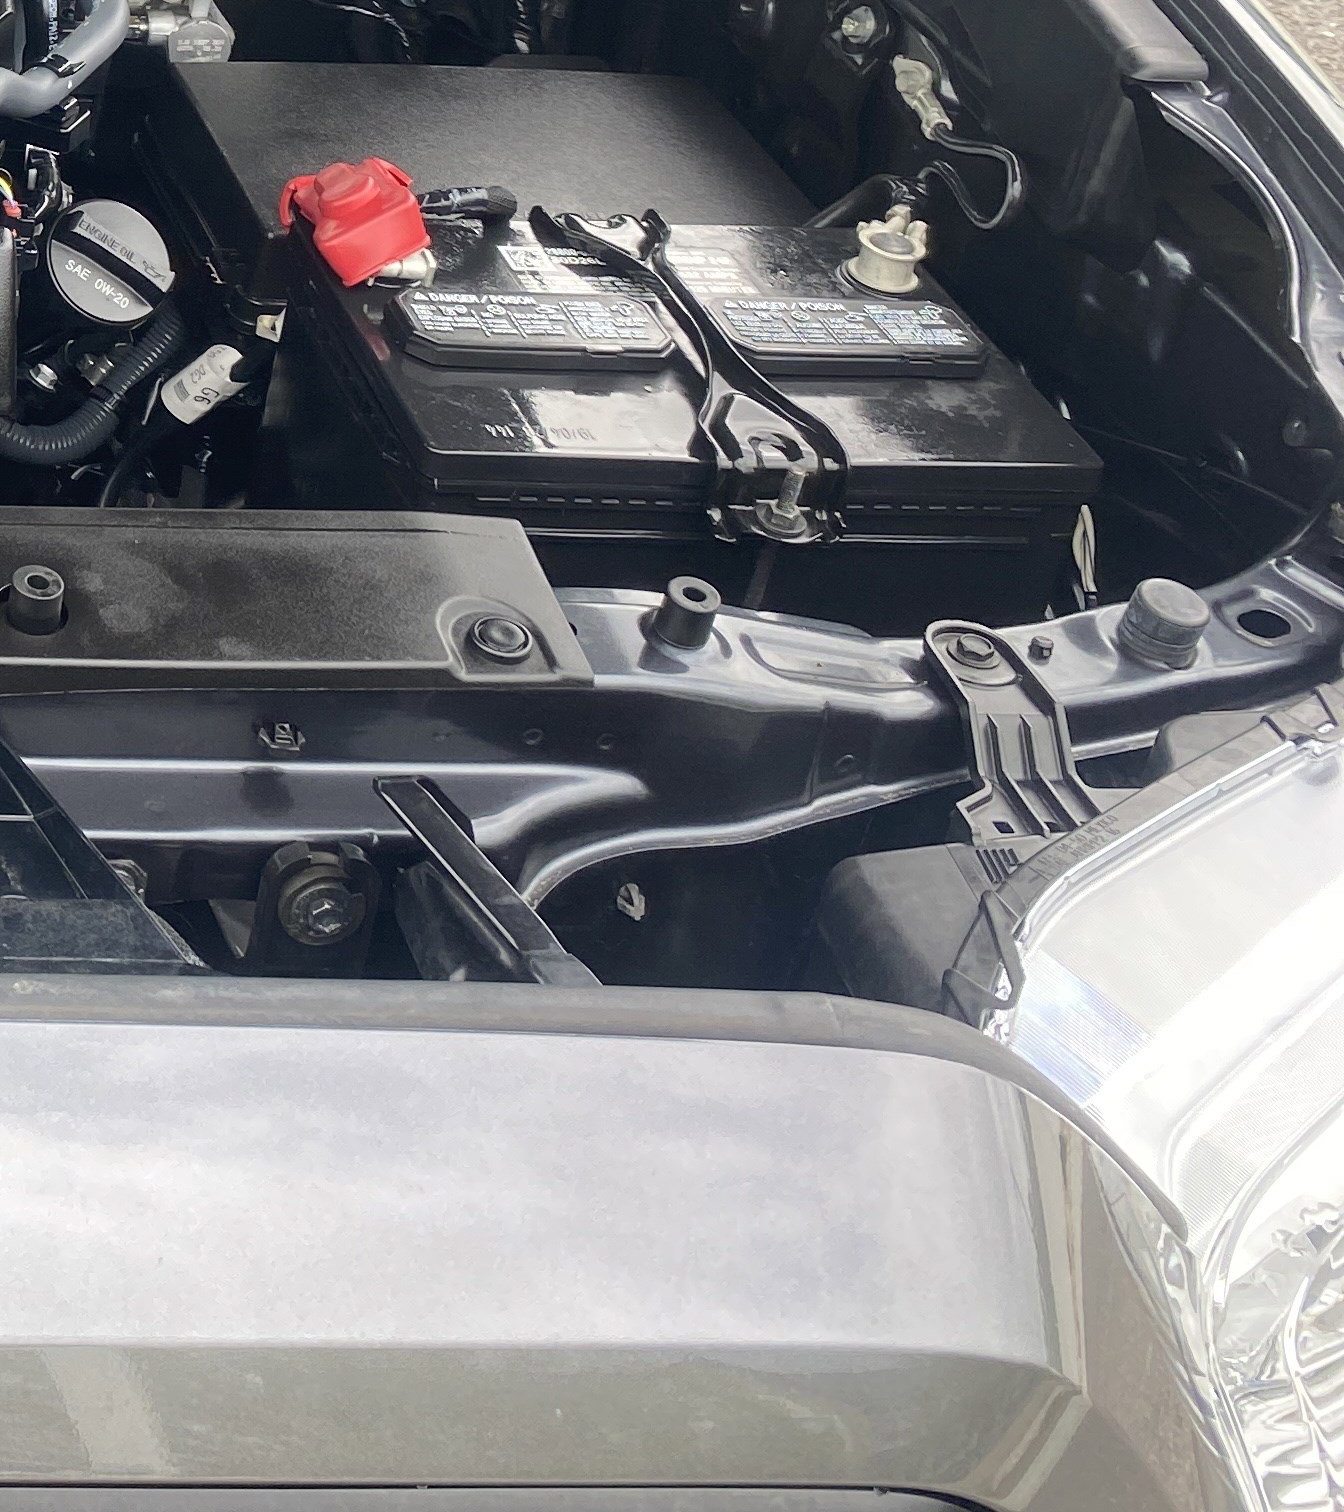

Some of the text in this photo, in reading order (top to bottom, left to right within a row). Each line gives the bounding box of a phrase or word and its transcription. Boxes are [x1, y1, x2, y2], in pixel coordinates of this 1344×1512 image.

[78, 218, 137, 264] ENGINE OIL
[65, 259, 130, 309] SAE 0W-20
[428, 292, 479, 303] DANGER
[488, 295, 536, 305] POISON
[738, 300, 787, 311] DANGER
[801, 302, 846, 312] POISON
